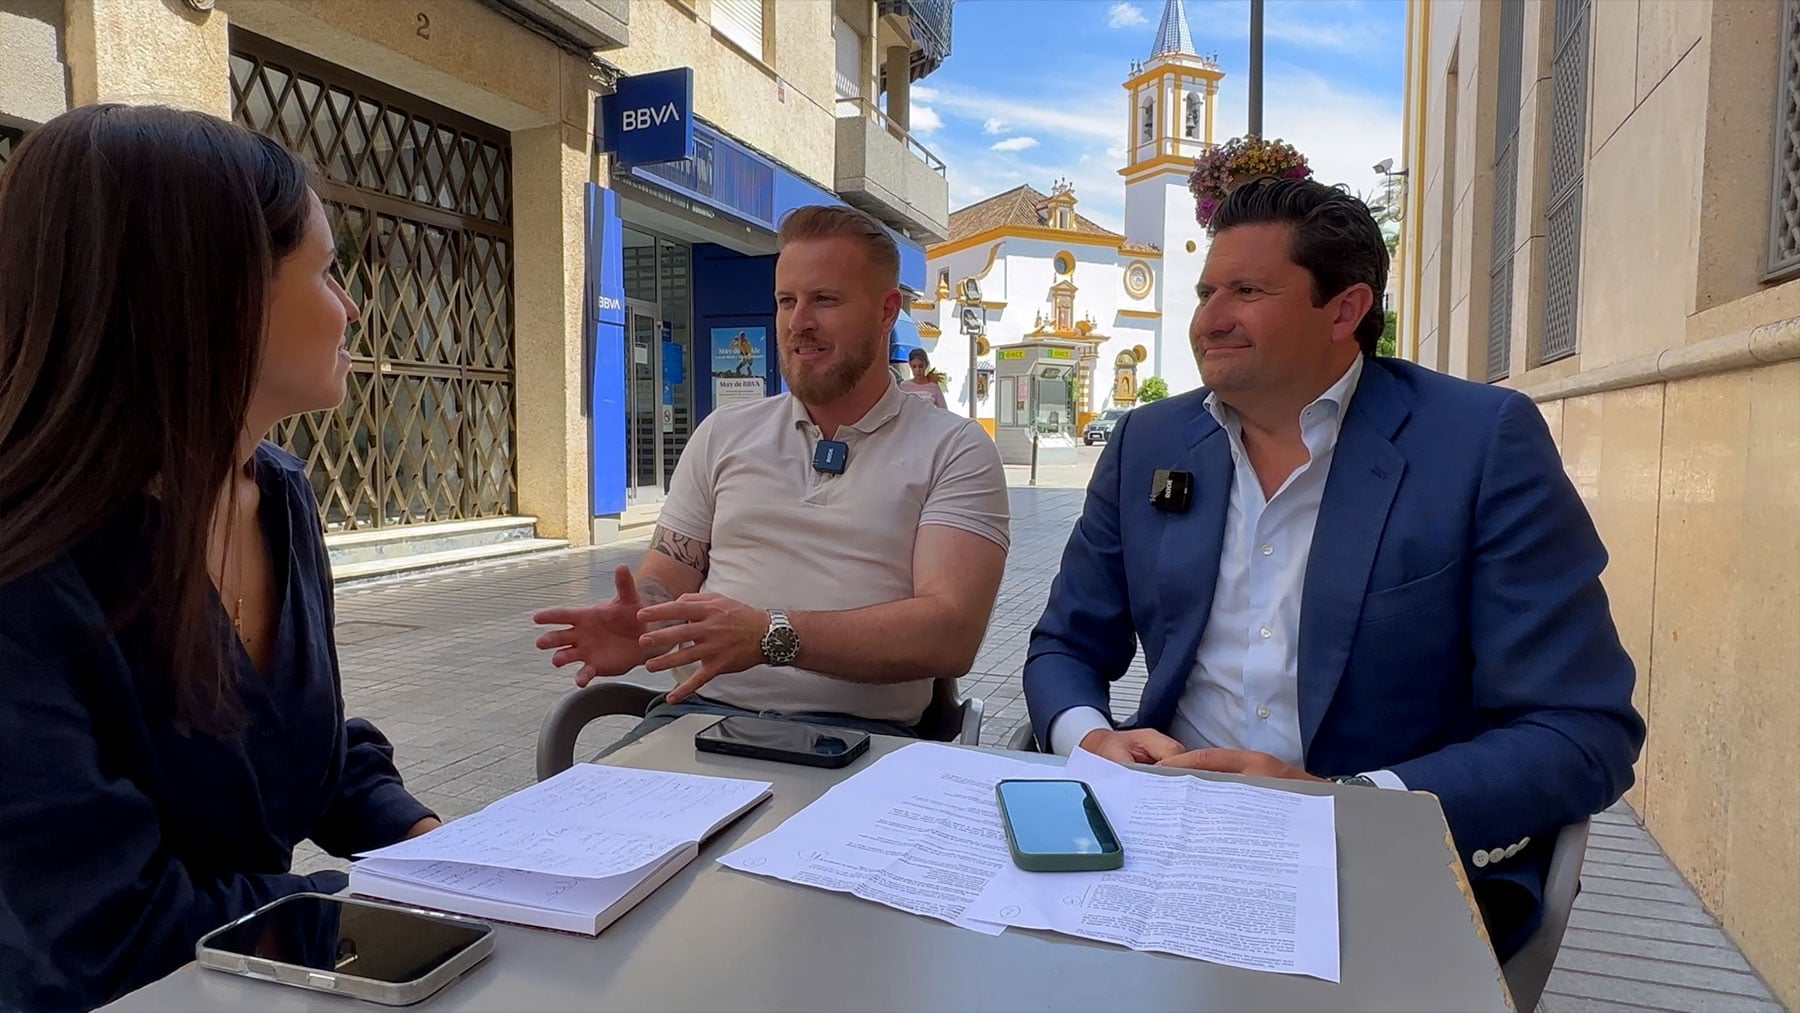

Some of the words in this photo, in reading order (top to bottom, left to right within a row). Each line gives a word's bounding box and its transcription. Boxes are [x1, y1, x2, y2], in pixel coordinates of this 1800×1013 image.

[416, 12, 430, 40] 2
[622, 102, 680, 131] BBVA
[598, 296, 621, 310] BBVA
[1005, 350, 1024, 359] ONCE
